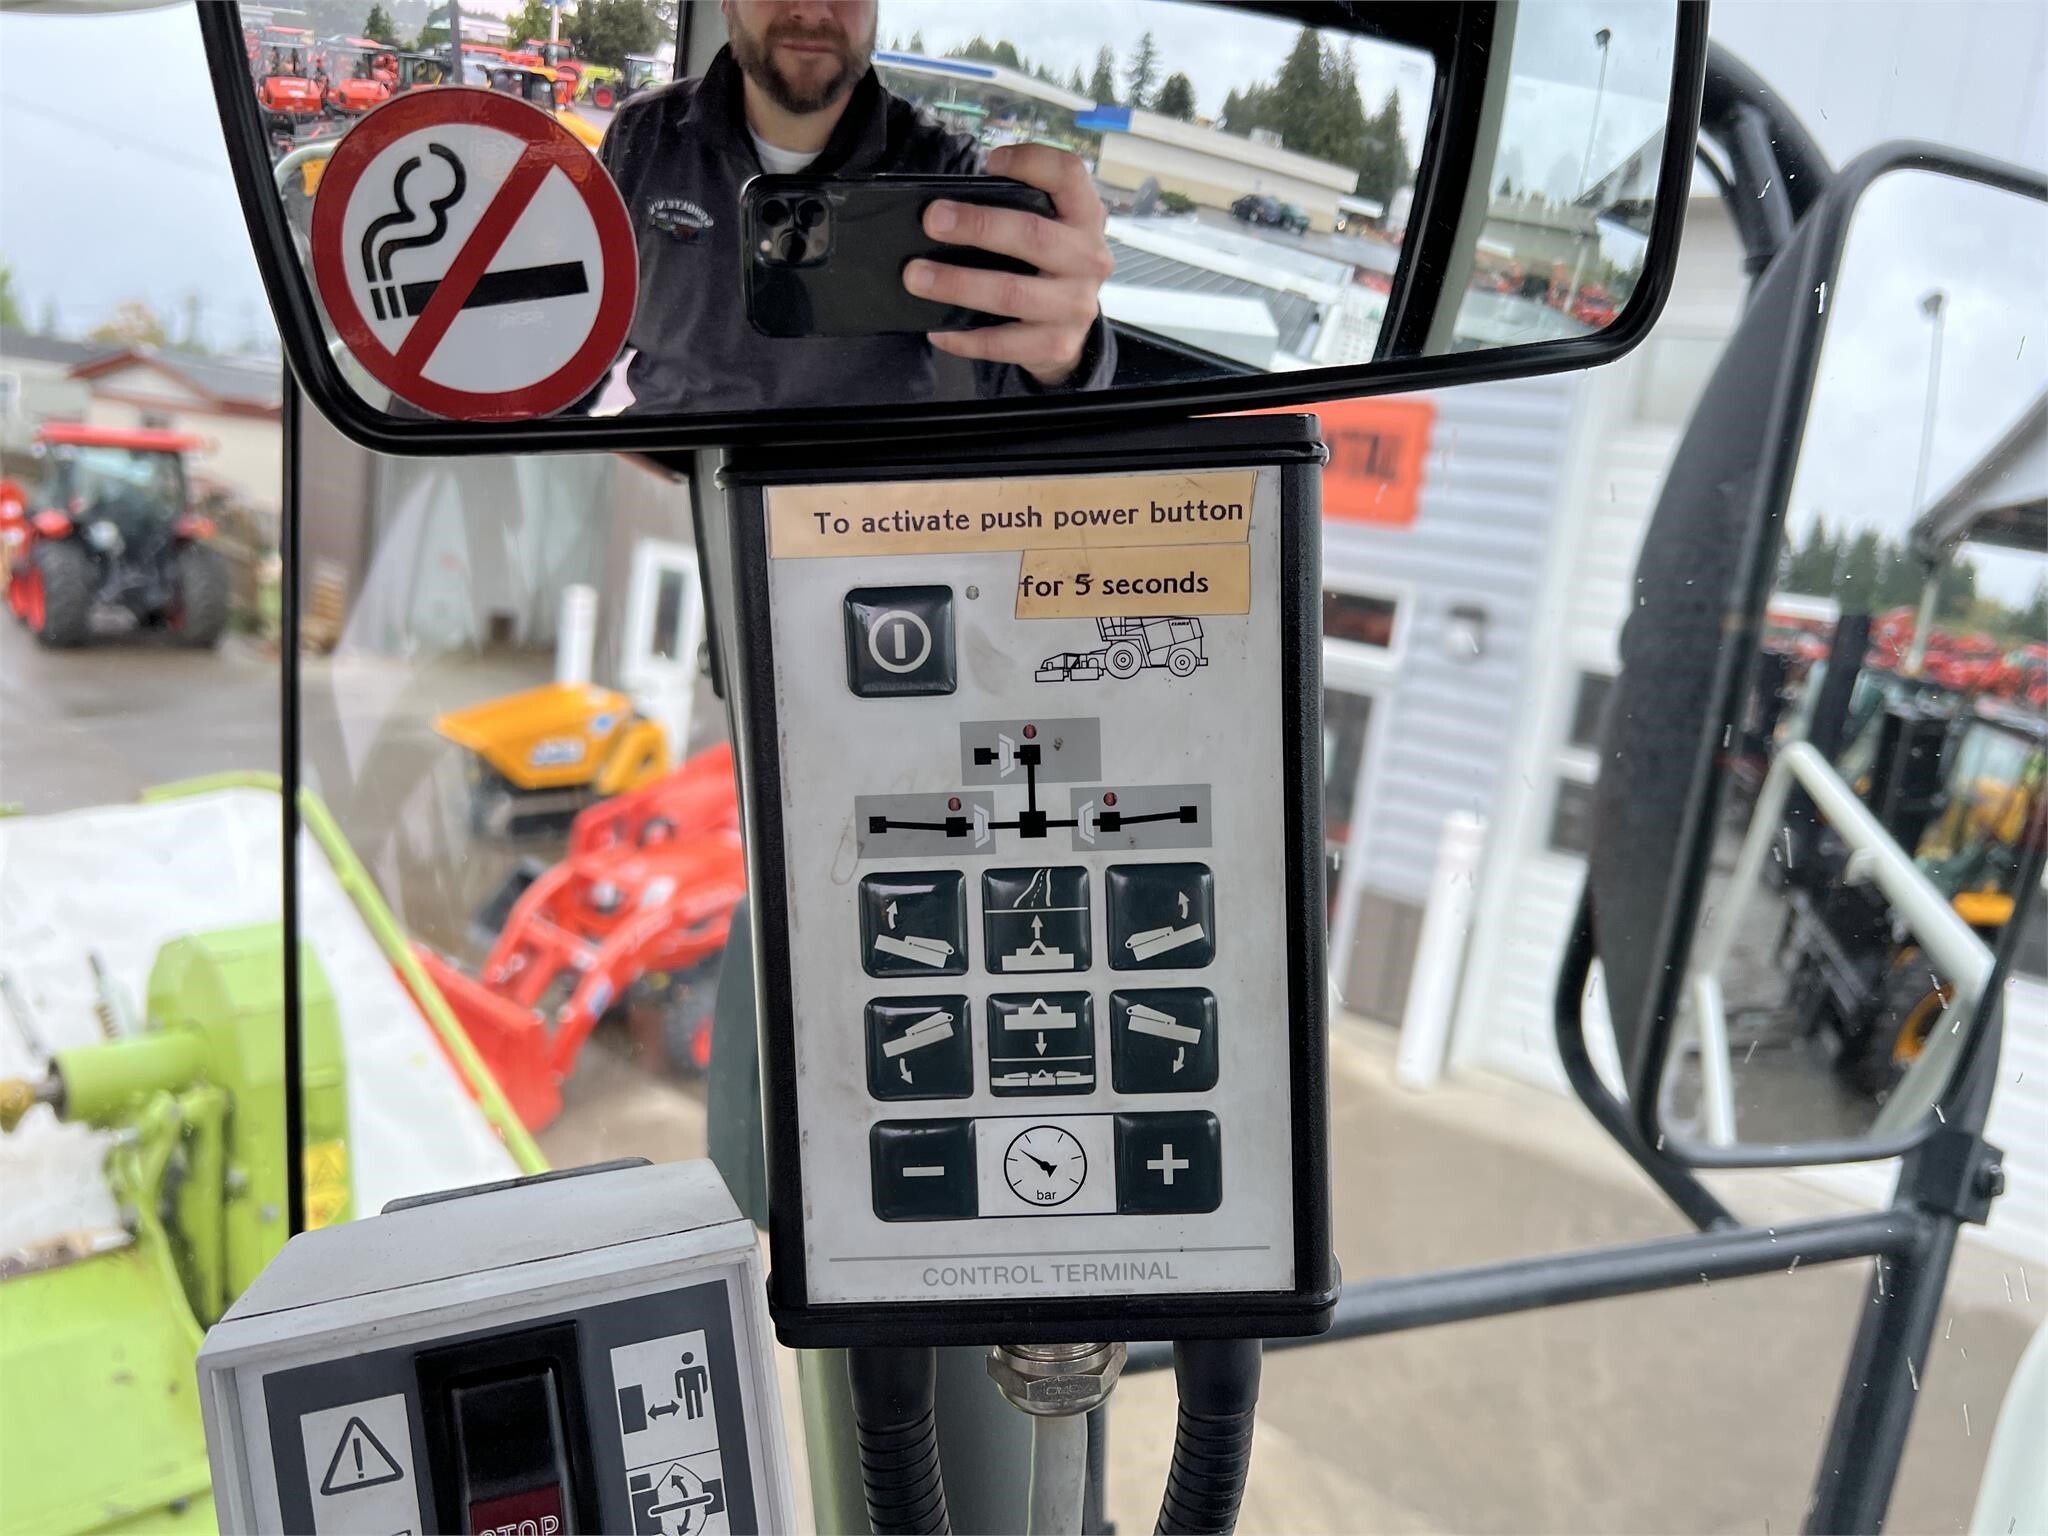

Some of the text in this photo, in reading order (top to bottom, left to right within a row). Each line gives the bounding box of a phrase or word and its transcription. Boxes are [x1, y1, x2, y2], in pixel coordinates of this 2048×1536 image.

[814, 499, 1243, 535] To activate push power button
[1021, 571, 1209, 598] for 5 seconds
[1036, 1189, 1057, 1201] bar
[922, 1262, 1179, 1287] CONTROL TERMINAL
